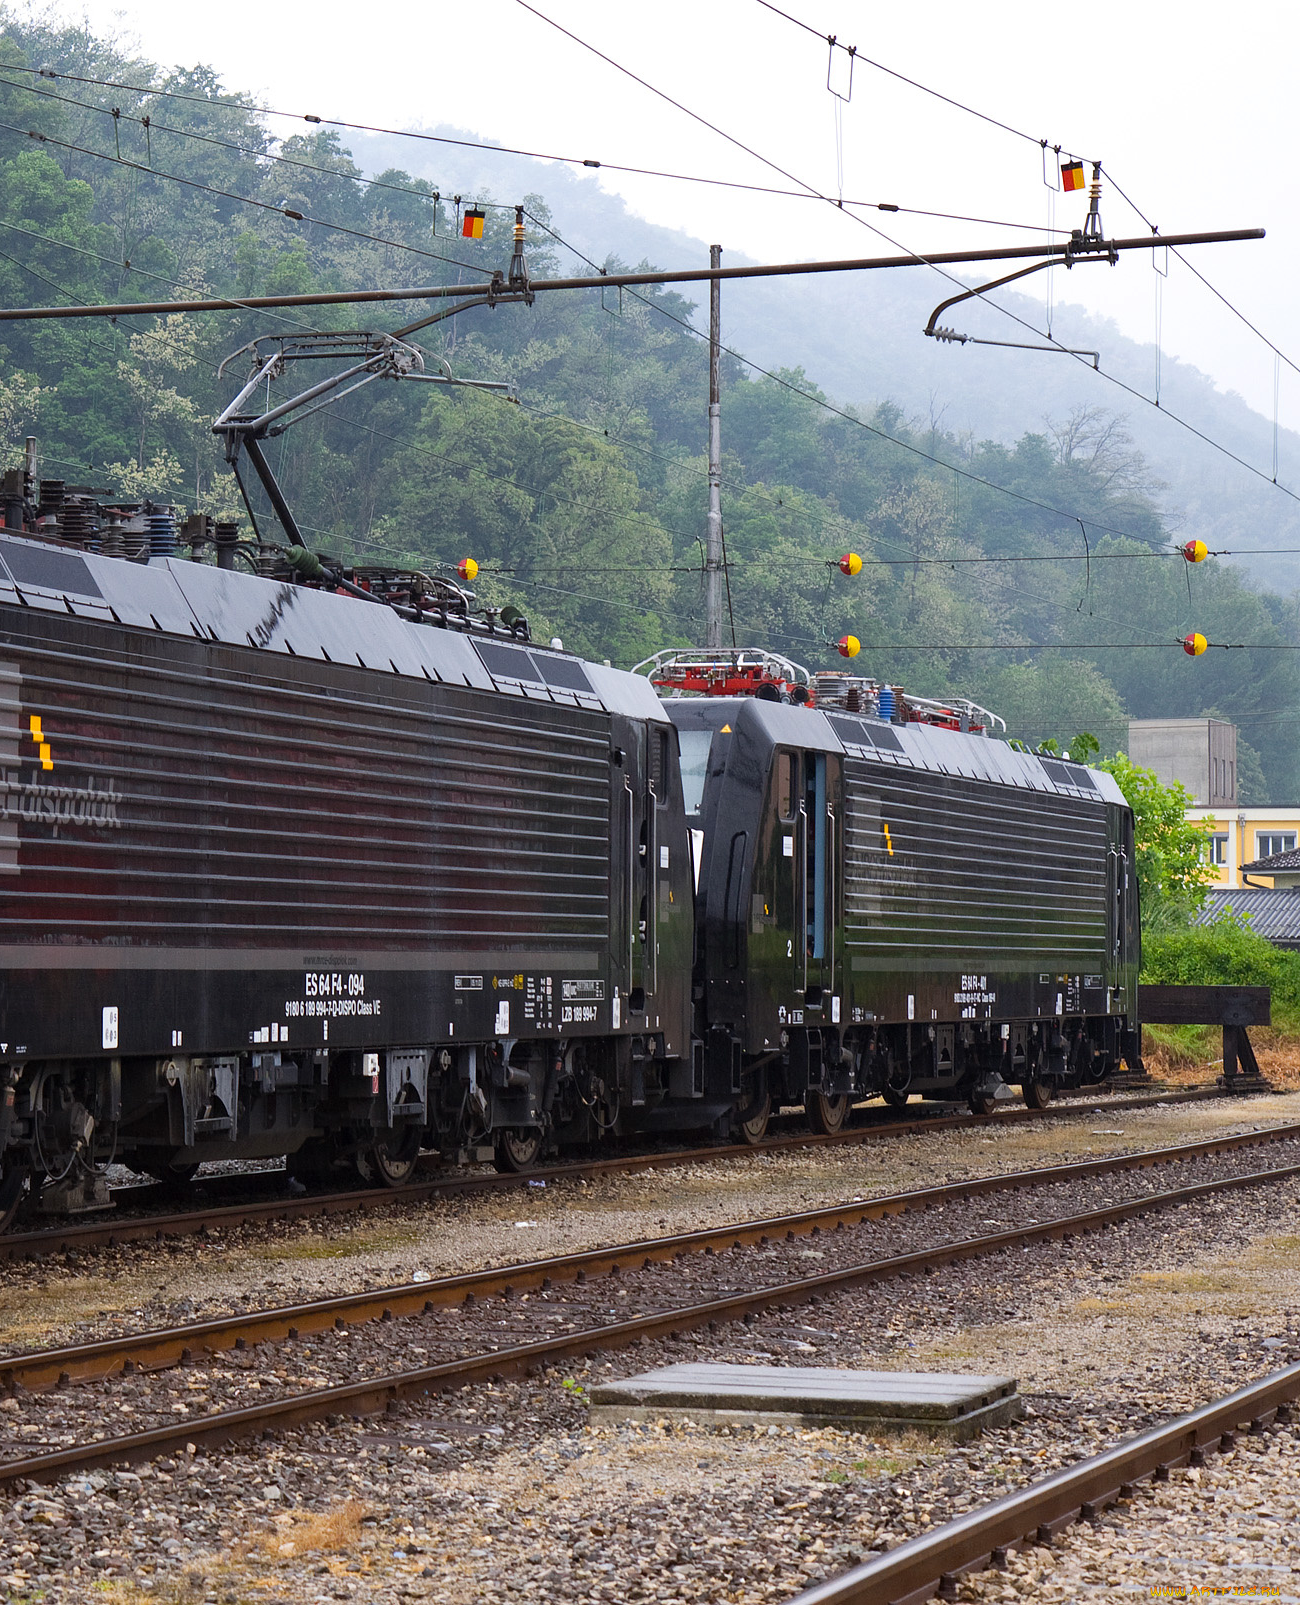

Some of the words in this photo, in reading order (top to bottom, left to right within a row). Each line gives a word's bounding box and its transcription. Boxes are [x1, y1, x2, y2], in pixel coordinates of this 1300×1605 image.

[787, 939, 792, 958] 2
[305, 973, 318, 996] ES
[319, 973, 330, 996] 64
[331, 973, 343, 996] F4
[348, 974, 365, 996] 094
[285, 1001, 299, 1017] 9180
[299, 1001, 304, 1017] 6
[305, 1001, 316, 1017] 189
[561, 1006, 572, 1023] LZB
[573, 1006, 582, 1022] 189
[583, 1005, 598, 1022] 994-7
